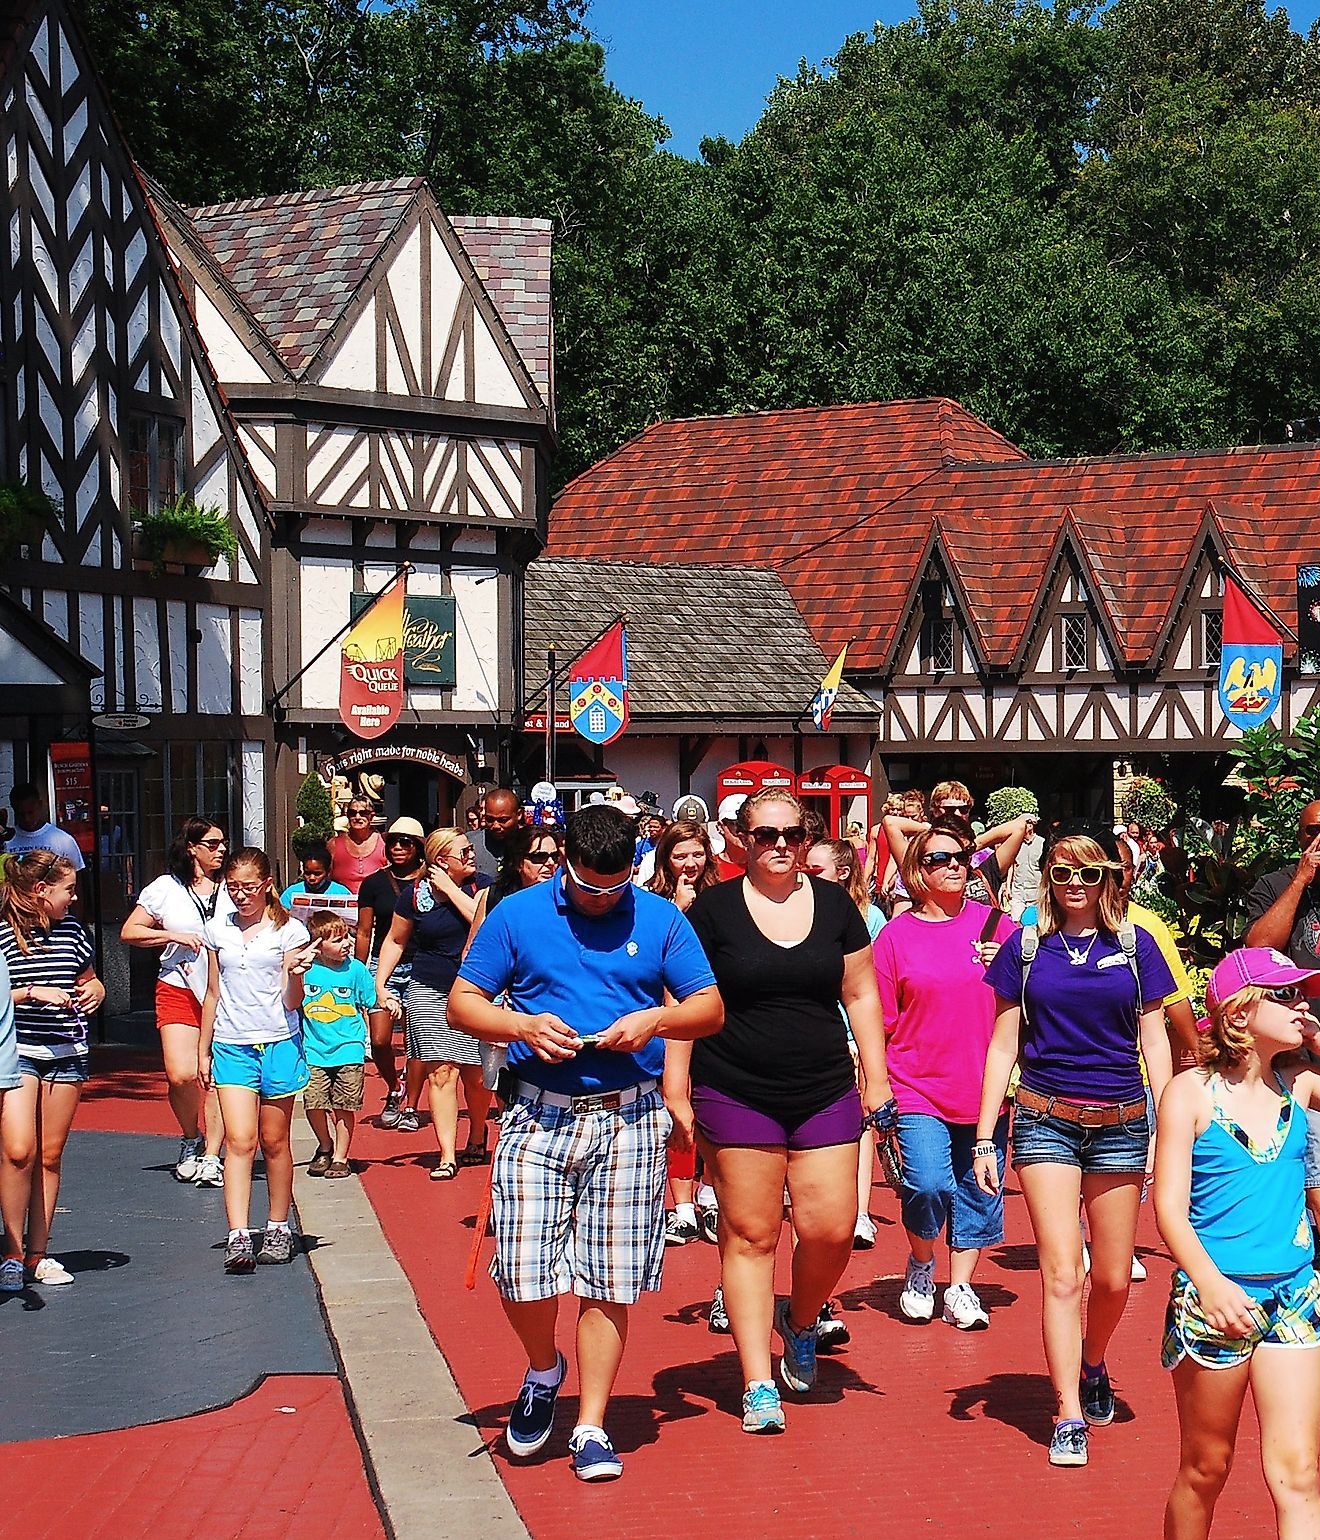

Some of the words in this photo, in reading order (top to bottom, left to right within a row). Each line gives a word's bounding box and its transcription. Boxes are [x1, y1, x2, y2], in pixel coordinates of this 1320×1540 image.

[344, 664, 399, 683] QUICK
[368, 681, 399, 693] QUEUE
[350, 704, 390, 716] Available
[536, 718, 545, 728] &
[349, 748, 373, 764] right
[375, 744, 401, 757] made
[402, 745, 416, 758] for
[416, 749, 440, 763] noble
[440, 754, 464, 776] heads
